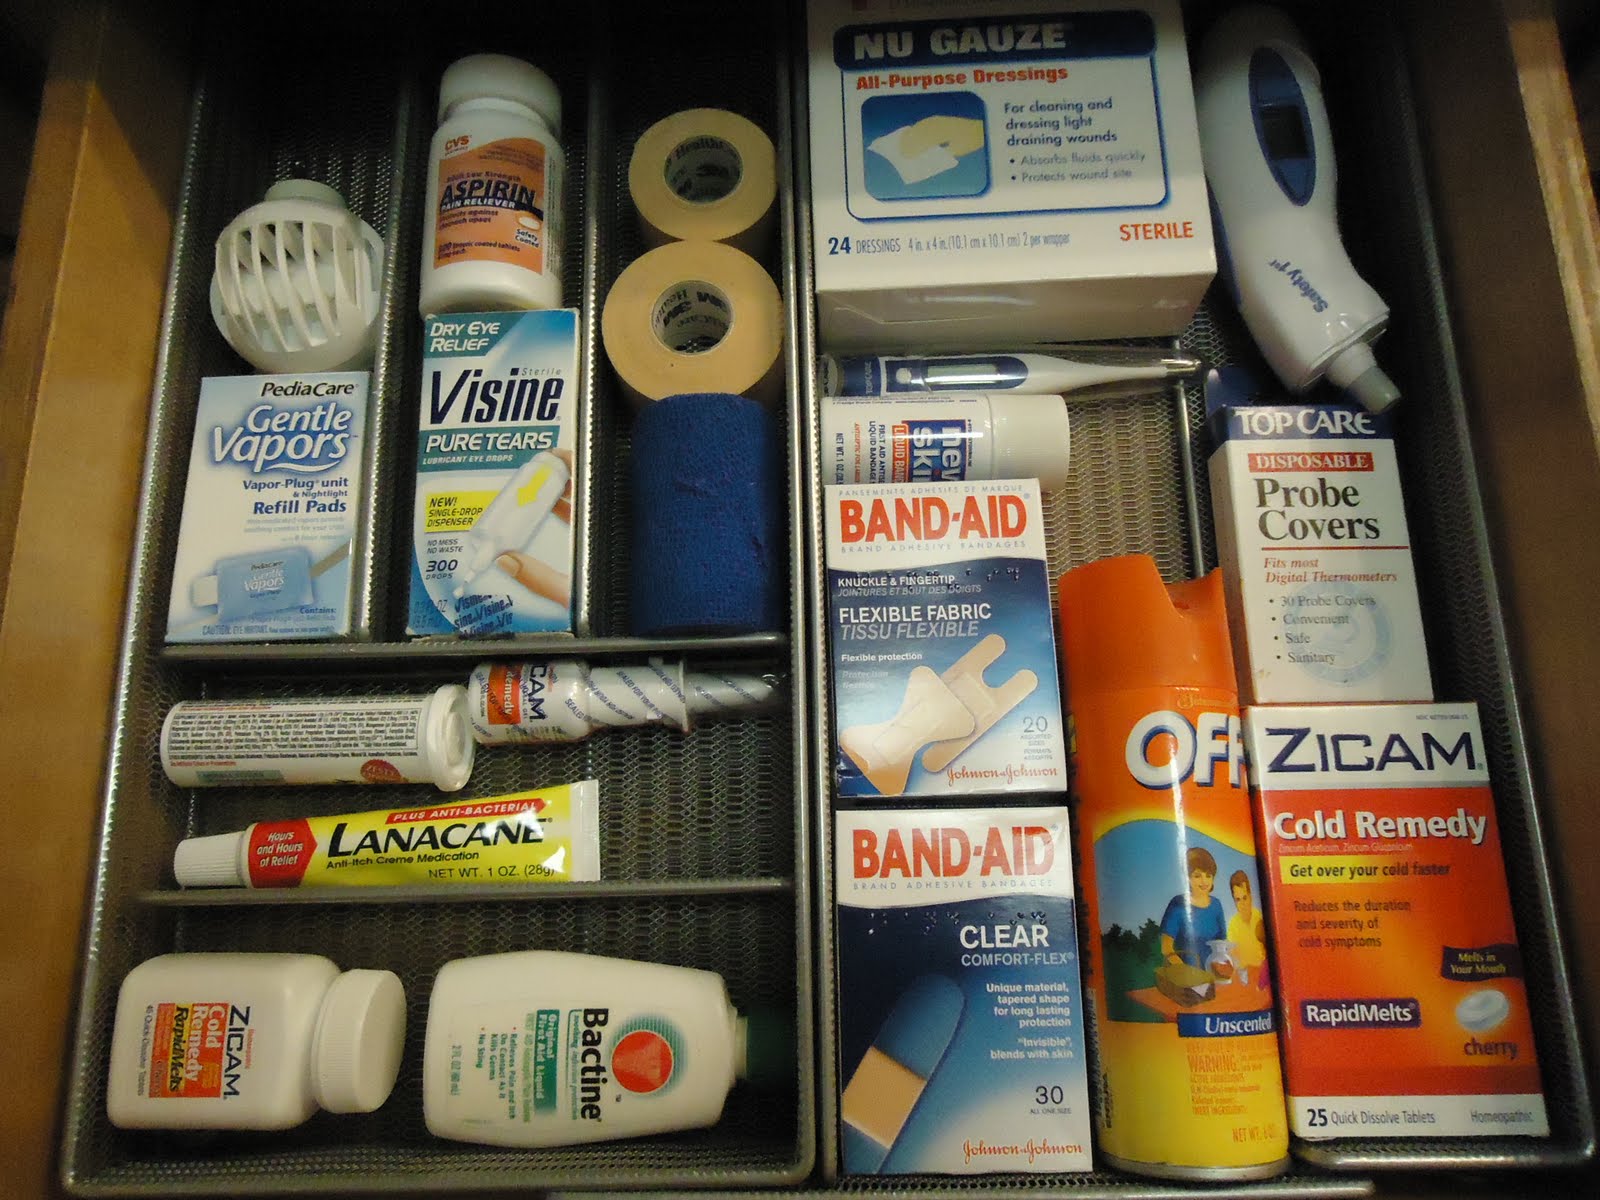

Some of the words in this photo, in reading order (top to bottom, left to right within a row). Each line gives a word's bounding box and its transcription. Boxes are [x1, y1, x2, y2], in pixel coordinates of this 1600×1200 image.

[854, 31, 914, 61] NU
[929, 22, 1067, 56] GAUZE
[856, 69, 967, 91] All-Purpose
[973, 66, 1069, 84] Dressings
[1004, 102, 1027, 114] For
[1029, 99, 1084, 115] cleaning
[1087, 97, 1113, 110] and
[1006, 117, 1060, 132] dressing
[1063, 116, 1092, 130] light
[445, 135, 470, 151] CVS
[1006, 133, 1062, 148] draining
[1066, 131, 1118, 144] wounds
[1105, 150, 1147, 165] quickly
[441, 179, 536, 208] ASPIRIN
[463, 198, 516, 209] RELIEVER
[1119, 222, 1194, 243] STERILE
[828, 236, 852, 255] 24
[856, 238, 901, 254] DRESSINGS
[430, 322, 465, 337] DRY
[468, 321, 500, 335] EYE
[430, 338, 489, 352] RELIEF
[522, 367, 562, 377] Sterile
[261, 382, 355, 397] PediaCare
[430, 367, 564, 424] Visine
[247, 402, 352, 433] Gentle
[1233, 409, 1293, 436] TOP
[1297, 409, 1376, 436] CARE
[868, 421, 877, 445] LIQUID
[214, 427, 350, 473] Vapors
[425, 433, 482, 453] PURE
[485, 431, 553, 450] TEARS
[893, 426, 906, 458] LIQUID
[422, 455, 467, 465] LUBRICANT
[468, 455, 484, 463] EYE
[486, 454, 513, 462] DROPS
[868, 447, 877, 480] BANDAGE
[1257, 454, 1368, 469] DISPOSABLE
[243, 478, 315, 492] Vapor-Plug
[321, 477, 349, 488] unit
[839, 487, 905, 496] PANSEMENTS
[1253, 477, 1360, 508] Probe
[301, 489, 348, 500] Nightlight
[429, 497, 458, 508] NEW!
[253, 499, 299, 515] Refill
[306, 499, 347, 514] Pads
[428, 507, 484, 518] SINGLE-DROP
[426, 517, 474, 529] DISPENSER
[840, 494, 1027, 543] BAND-AID
[1258, 509, 1380, 541] Covers
[841, 545, 882, 554] BRAND
[890, 543, 951, 552] ADHESIVE
[960, 540, 1026, 550] BANDAGES
[425, 559, 458, 572] 300
[1264, 557, 1287, 569] Fits
[1290, 558, 1319, 568] most
[838, 577, 887, 588] KNUCKLE
[899, 574, 955, 586] FINGERTIP
[1265, 571, 1308, 585] Digital
[1313, 571, 1398, 582] Thermometers
[838, 586, 887, 597] JOINTURES
[1298, 595, 1331, 607] Probe
[839, 606, 921, 624] FLEXIBLE
[927, 603, 992, 621] FABRIC
[1283, 612, 1350, 625] Convenient
[841, 623, 892, 640] TISSU
[897, 620, 979, 639] FLEXIBLE
[1285, 632, 1310, 644] Safe
[841, 653, 876, 663] Flexible
[878, 652, 923, 663] protection
[1288, 652, 1336, 665] Sanitary
[1023, 716, 1048, 733] 20
[1265, 727, 1476, 773] ZICAM
[393, 811, 427, 823] PLUS
[430, 801, 538, 819] ANTI-BACTERIAL
[1274, 809, 1347, 840] Cold
[1355, 808, 1487, 844] Remedy
[267, 831, 295, 843] Hours
[328, 820, 546, 858] LANACANE
[256, 843, 274, 855] and
[275, 842, 304, 854] Hours
[853, 827, 1055, 878] BAND-AID
[270, 854, 299, 867] Relief
[326, 855, 373, 870] Anti-Itch
[374, 854, 414, 867] Creme
[417, 850, 480, 863] Medication
[429, 868, 455, 879] NET
[458, 867, 483, 878] WT.
[498, 865, 521, 877] OZ.
[1290, 864, 1312, 877] Get
[1316, 865, 1345, 877] over
[1349, 865, 1378, 880] your
[1382, 863, 1408, 875] cold
[1412, 862, 1450, 875] faster
[853, 882, 897, 890] BRAND
[907, 880, 973, 890] ADHESIVE
[1294, 900, 1339, 912] Reduces
[1343, 900, 1361, 911] the
[1364, 899, 1411, 911] duration
[1296, 918, 1317, 930] and
[1320, 918, 1364, 931] severity
[1367, 917, 1379, 929] of
[960, 925, 1049, 949] CLEAR
[1324, 935, 1382, 950] symptoms
[1475, 963, 1506, 974] Mouth
[986, 983, 1022, 994] Unique
[1024, 982, 1069, 993] material,
[998, 995, 1036, 1006] tapered
[1039, 995, 1070, 1006] shape
[994, 1006, 1008, 1016] for
[1011, 1006, 1033, 1018] long
[1036, 1005, 1070, 1017] lasting
[1306, 1003, 1413, 1026] RapidMelts
[205, 1005, 225, 1049] Cold
[1019, 1017, 1071, 1029] protection
[1205, 1012, 1272, 1034] Unscented
[188, 1005, 208, 1082] Remedy
[489, 1033, 499, 1052] Kills
[546, 1014, 558, 1058] Original
[169, 1006, 189, 1092] RapidMelts
[223, 1005, 251, 1098] ZICAM
[508, 1033, 518, 1067] Relieves
[537, 1043, 546, 1061] Aid
[991, 1049, 1025, 1060] blends
[1028, 1049, 1047, 1060] with
[1049, 1049, 1073, 1059] skin
[1464, 1037, 1518, 1060] cherry
[475, 1047, 486, 1069] Sting
[499, 1047, 508, 1078] Contact
[581, 1008, 609, 1121] Bactine
[508, 1070, 517, 1087] Pain
[535, 1065, 546, 1099] Liquid
[1035, 1086, 1064, 1105] 30
[1307, 1108, 1327, 1127] 25
[1331, 1111, 1358, 1126] Quick
[1360, 1110, 1399, 1125] Dissolve
[1402, 1110, 1437, 1124] Tablets
[1471, 1110, 1534, 1126] Homeopathic
